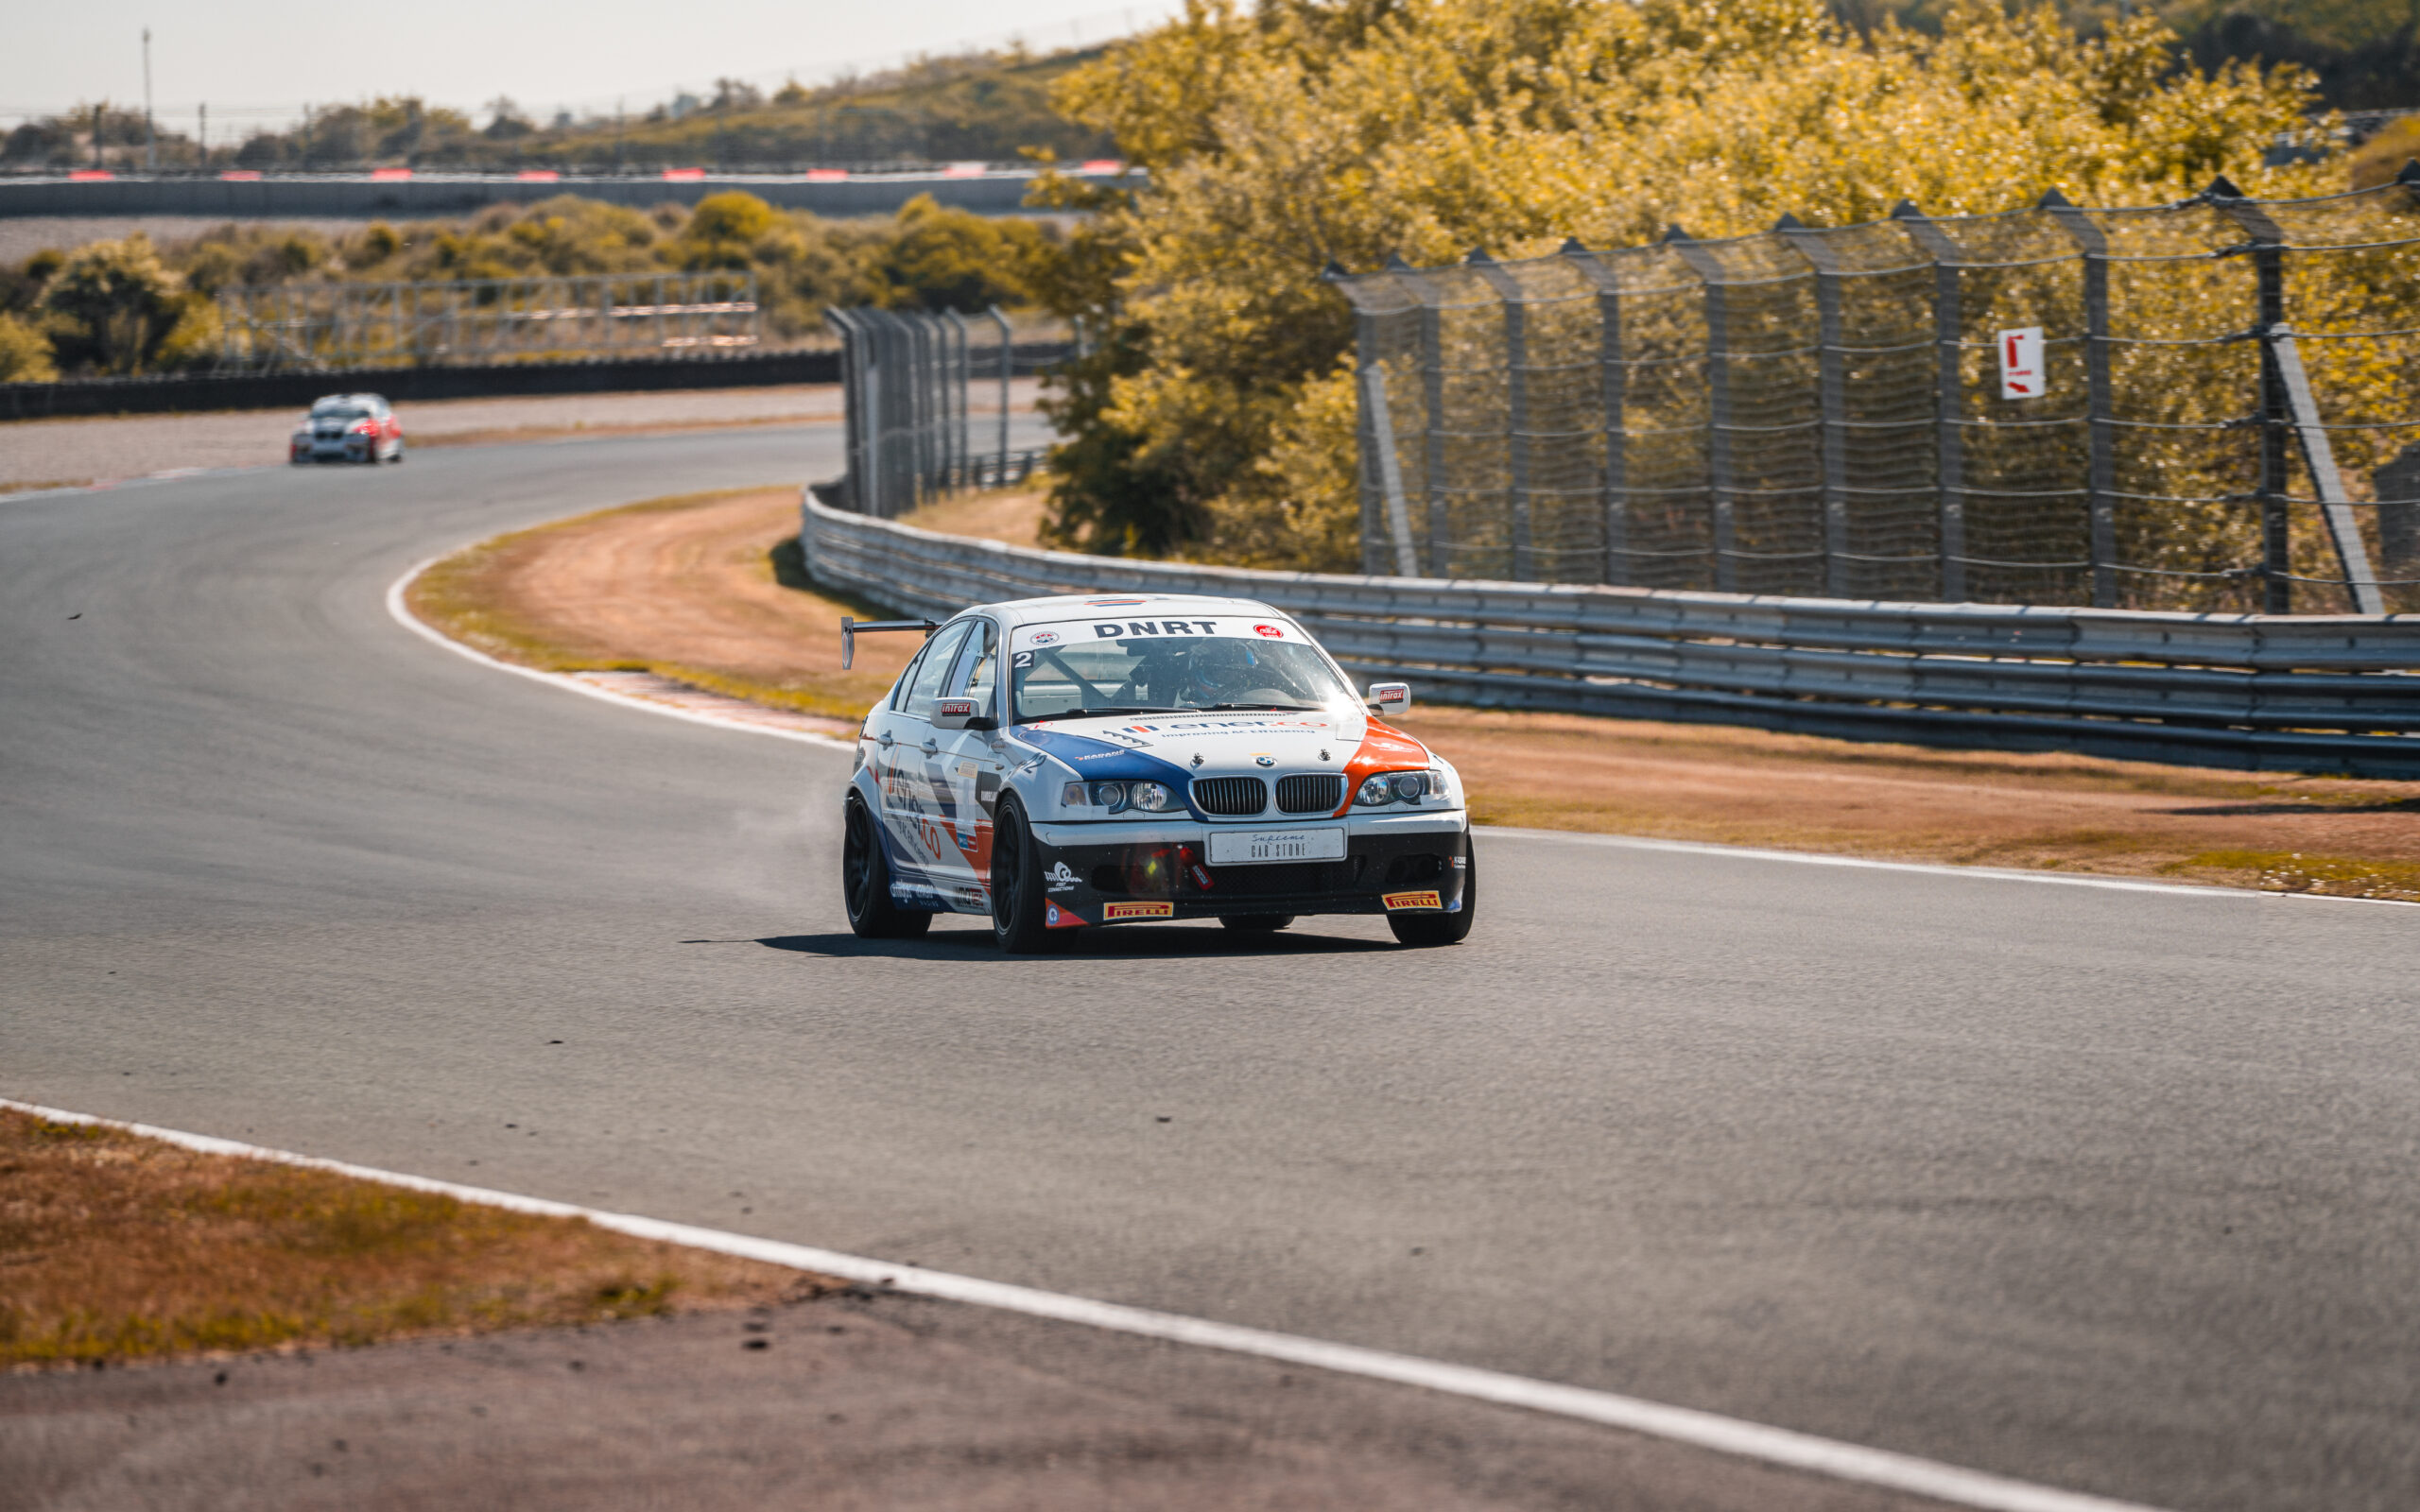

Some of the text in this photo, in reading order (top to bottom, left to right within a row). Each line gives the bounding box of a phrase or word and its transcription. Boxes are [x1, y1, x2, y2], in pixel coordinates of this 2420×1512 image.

[1094, 621, 1218, 638] DNRT
[1014, 652, 1032, 668] 2
[1276, 843, 1305, 856] STORE
[1385, 894, 1438, 907] PIRELLI
[1107, 904, 1169, 918] PIRELLI
